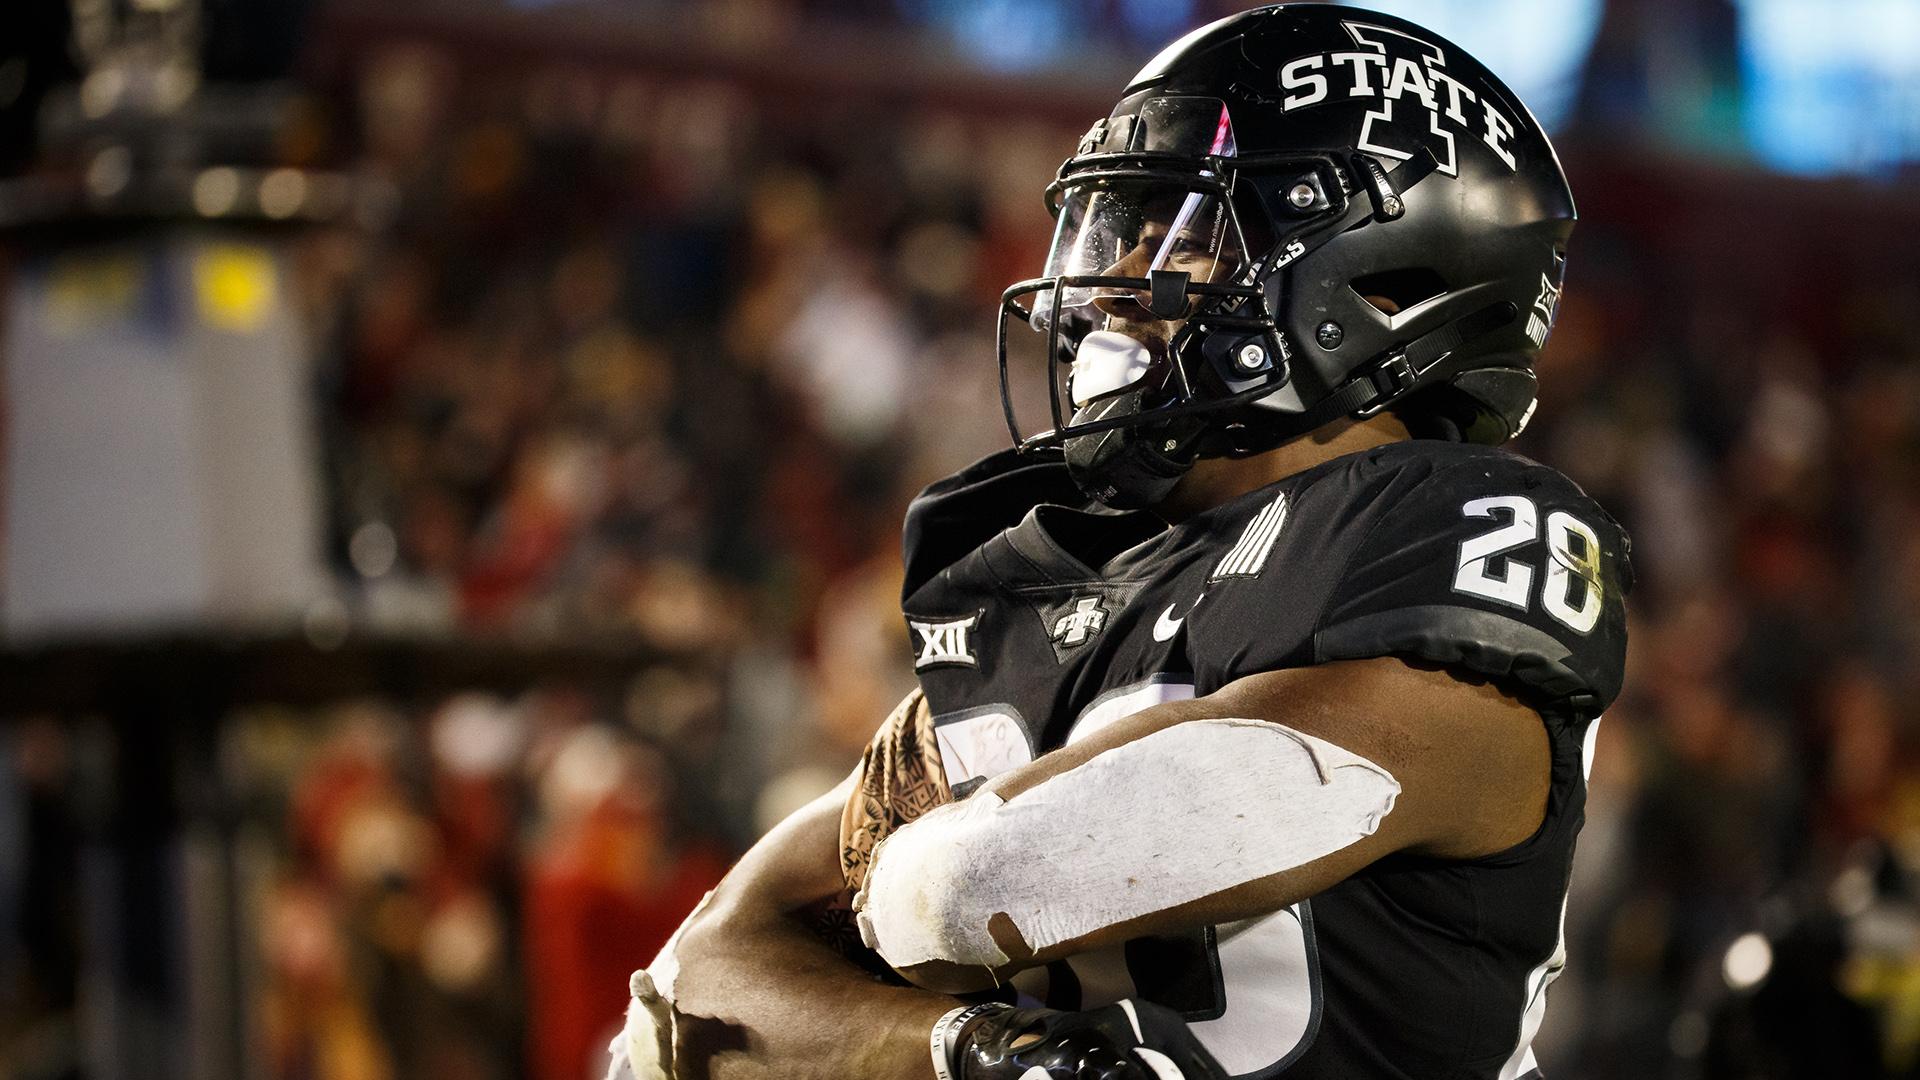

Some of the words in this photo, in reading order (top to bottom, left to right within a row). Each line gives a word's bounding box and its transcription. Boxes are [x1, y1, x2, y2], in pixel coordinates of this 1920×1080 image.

[1281, 52, 1516, 171] STATE
[1453, 495, 1602, 633] 28
[910, 616, 977, 668] XII
